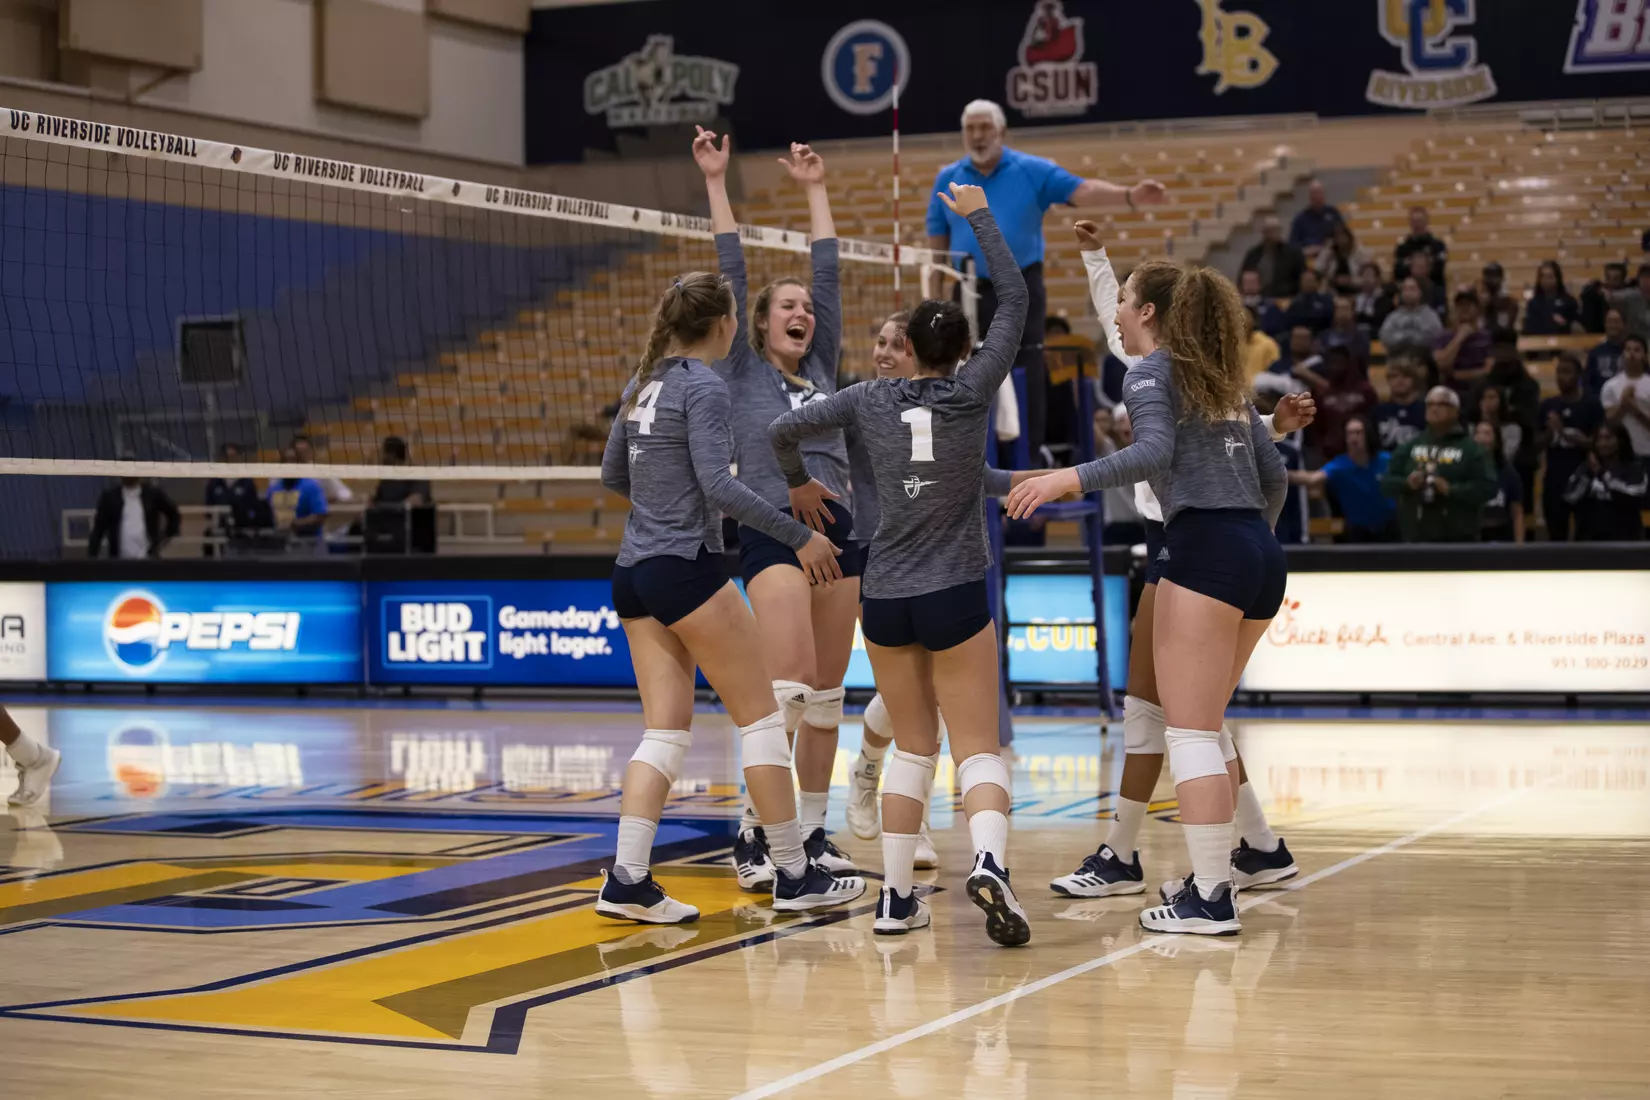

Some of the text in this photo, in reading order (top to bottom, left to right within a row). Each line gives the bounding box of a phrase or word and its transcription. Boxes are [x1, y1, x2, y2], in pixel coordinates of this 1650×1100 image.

[669, 56, 738, 103] POLY
[853, 43, 883, 94] F
[1012, 66, 1092, 103] CSUN
[10, 110, 198, 158] UC RIVERSIDE VOLLEYBALL
[273, 152, 425, 193] UC RIVERSIDE VOLLEYBALL
[485, 187, 609, 219] UC RIVERSIDE VOLLEYBALL
[628, 381, 663, 435] 4
[901, 406, 936, 462] 1
[158, 612, 300, 650] PEPSI
[401, 602, 472, 633] BUD
[499, 605, 620, 637] Gameday's
[388, 631, 486, 662] LIGHT
[499, 631, 612, 660] light lager.
[1403, 631, 1463, 646] Central
[1524, 631, 1598, 646] Riverside
[1604, 631, 1646, 646] Plaza
